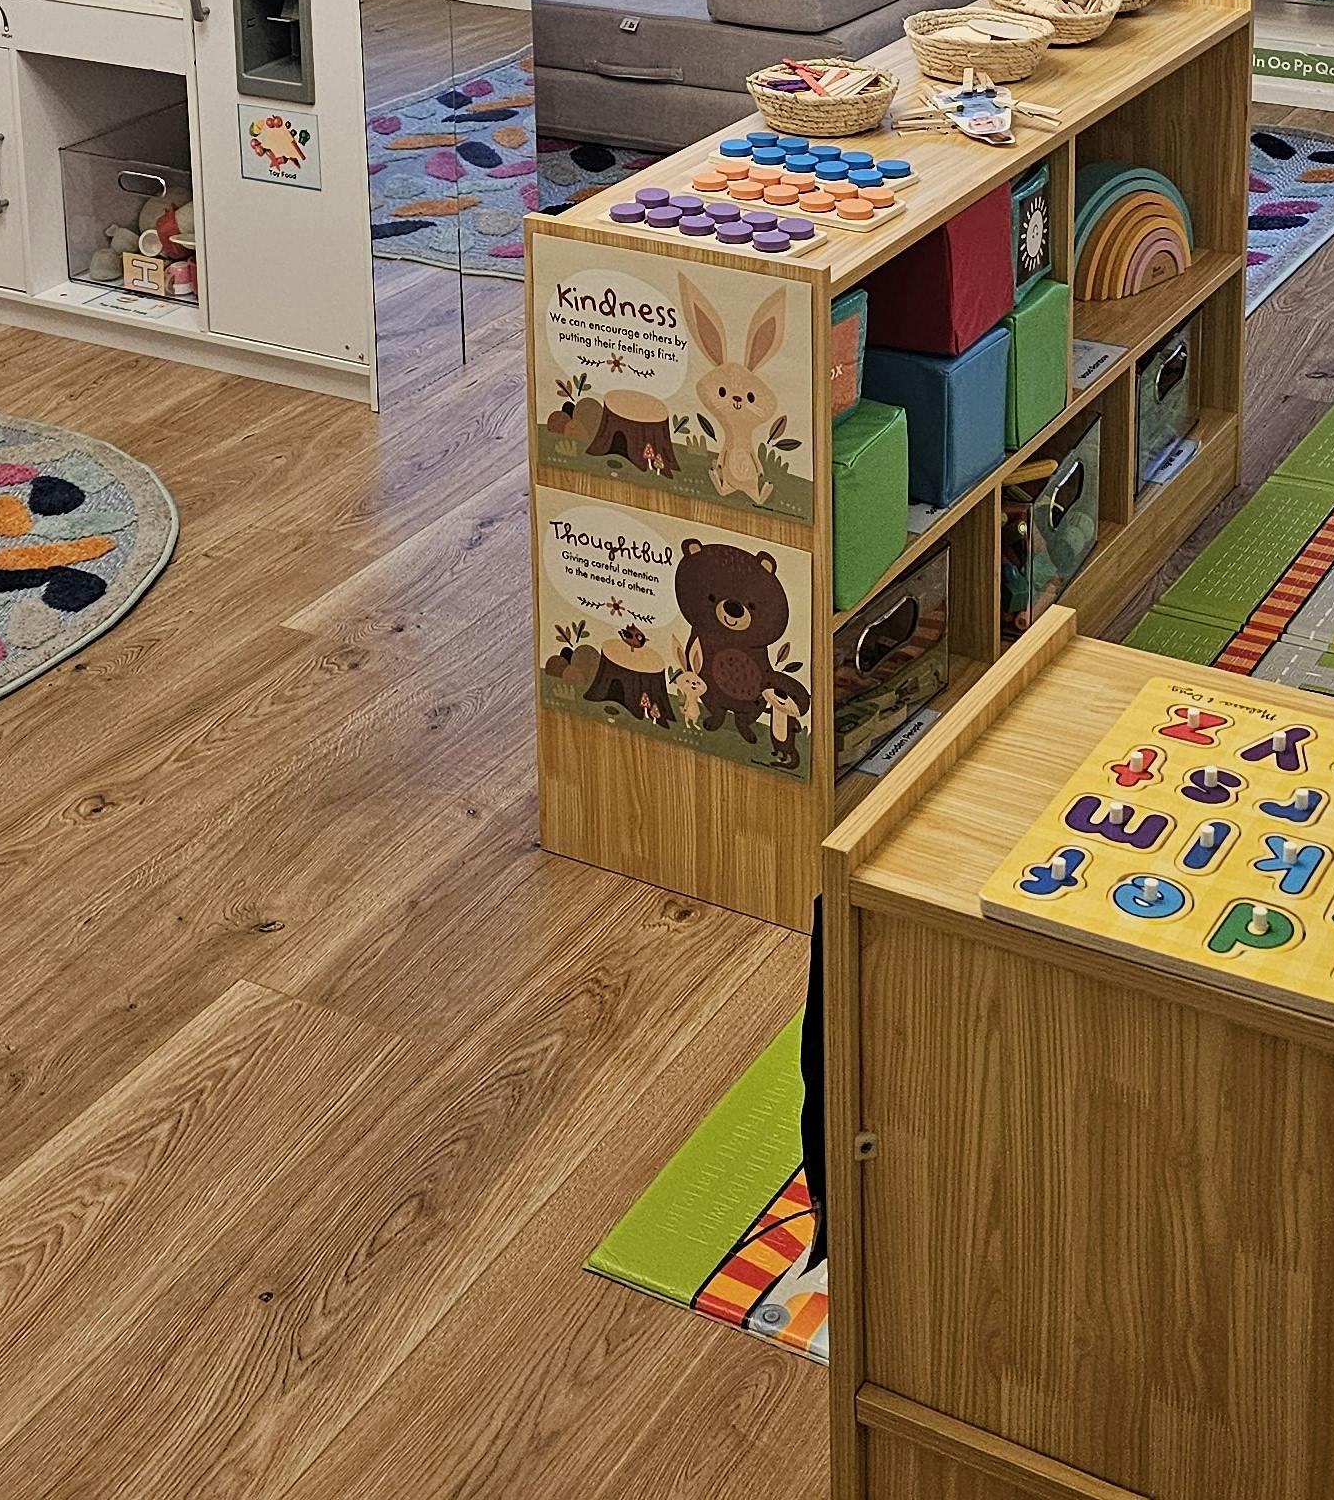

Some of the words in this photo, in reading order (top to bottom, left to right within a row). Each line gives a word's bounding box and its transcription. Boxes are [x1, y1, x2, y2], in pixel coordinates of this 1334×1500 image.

[1268, 57, 1291, 70] Oo
[1294, 60, 1312, 76] Pp
[281, 172, 297, 180] Food
[557, 284, 677, 328] Kindness
[550, 312, 567, 324] We
[569, 318, 586, 328] can
[588, 321, 640, 339] encourage
[643, 331, 672, 345] others
[675, 335, 687, 350] by
[559, 332, 592, 348] putting
[594, 336, 616, 350] their
[618, 340, 655, 359] feelings
[657, 347, 678, 363] first.
[549, 521, 672, 566] Thoughtful
[561, 550, 589, 567] Giving
[591, 559, 620, 574] careful
[622, 567, 659, 583] attention
[565, 566, 574, 574] to
[575, 566, 588, 579] the
[590, 573, 615, 585] needs
[617, 579, 626, 589] of
[627, 582, 656, 596] others.
